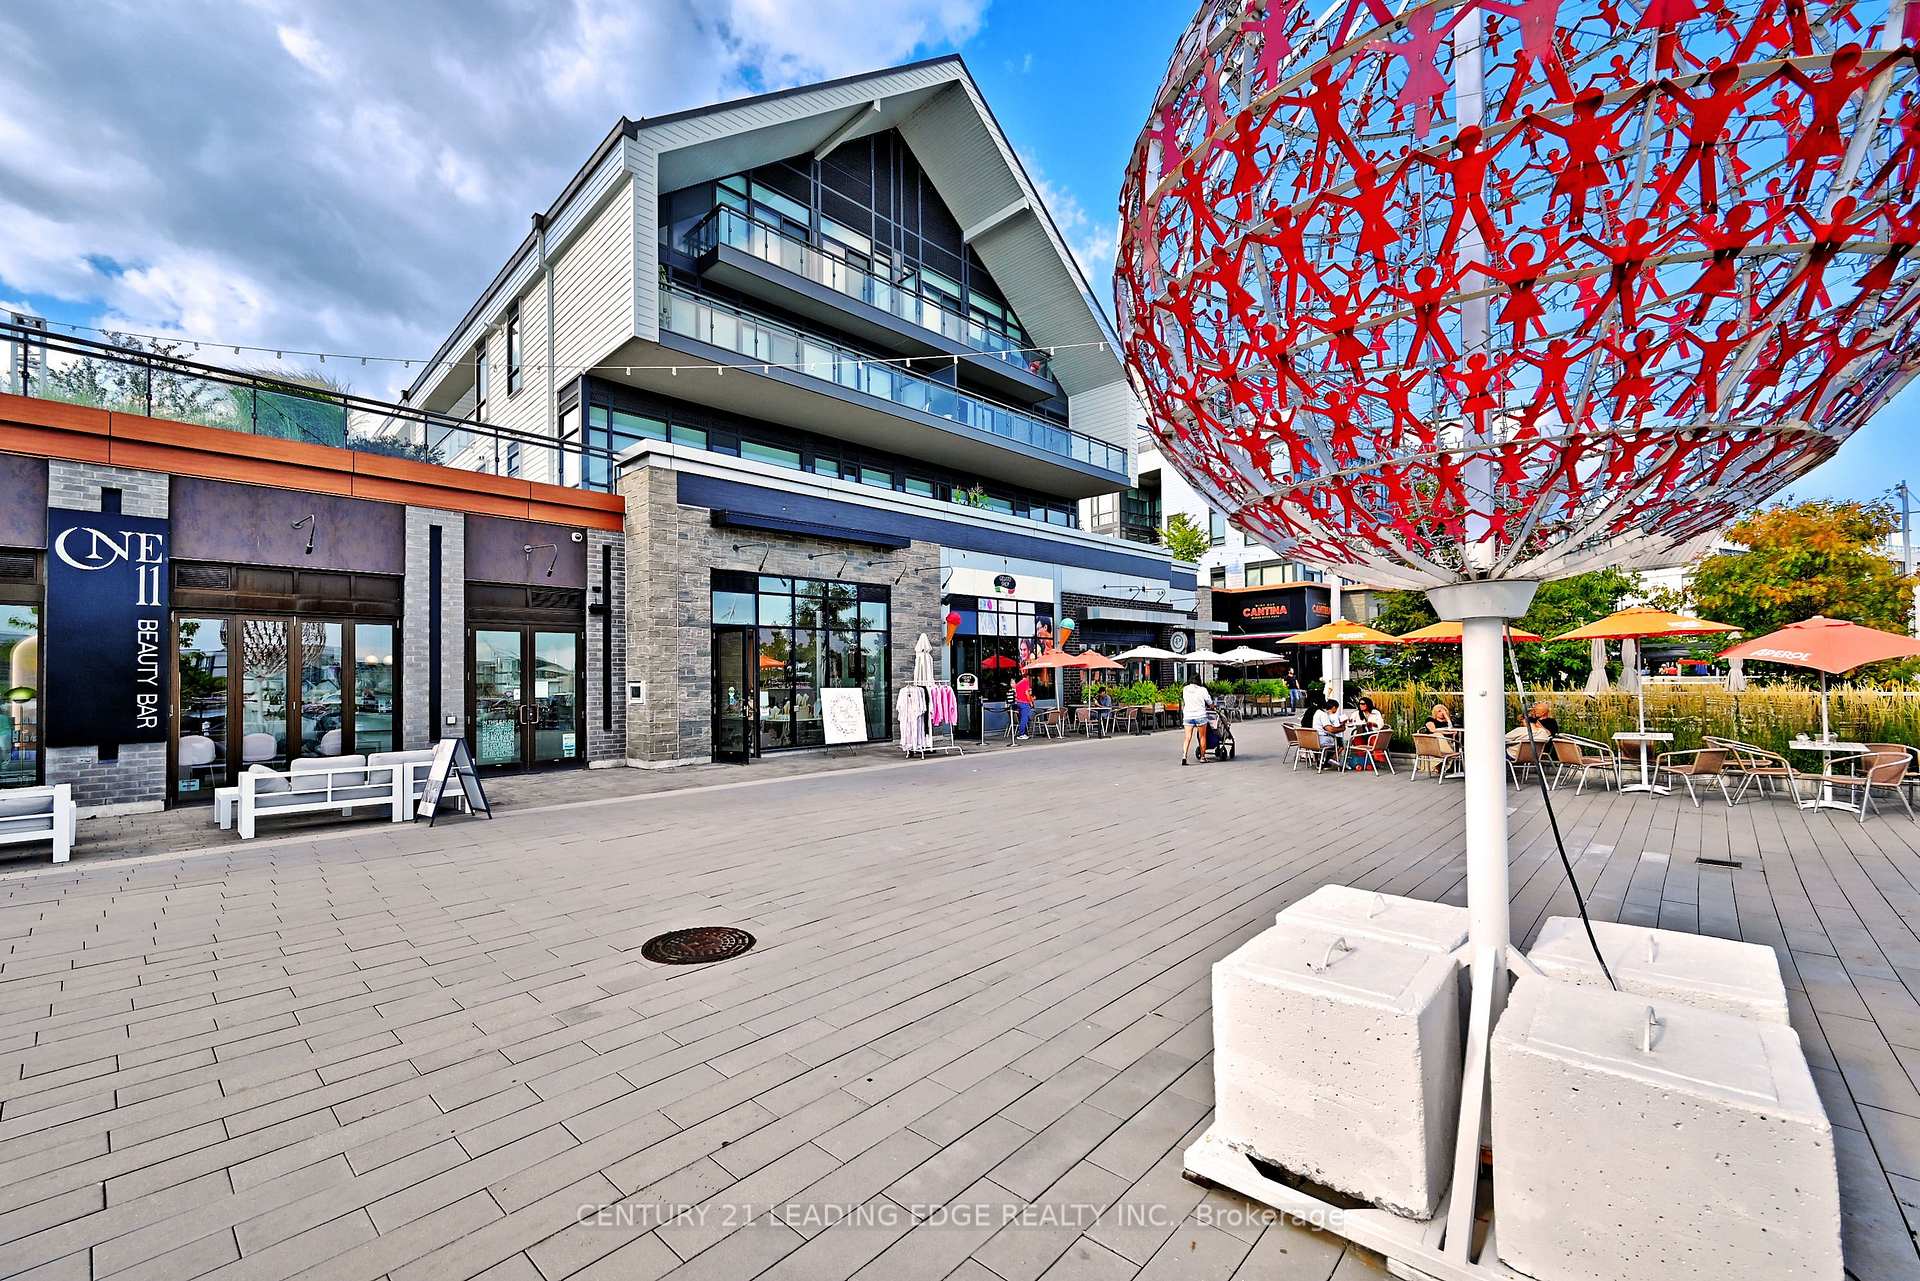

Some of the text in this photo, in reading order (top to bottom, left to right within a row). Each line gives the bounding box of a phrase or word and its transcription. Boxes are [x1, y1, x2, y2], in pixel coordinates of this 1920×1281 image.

[1242, 604, 1288, 617] CANTINA
[136, 619, 159, 729] BEAUTY BAR
